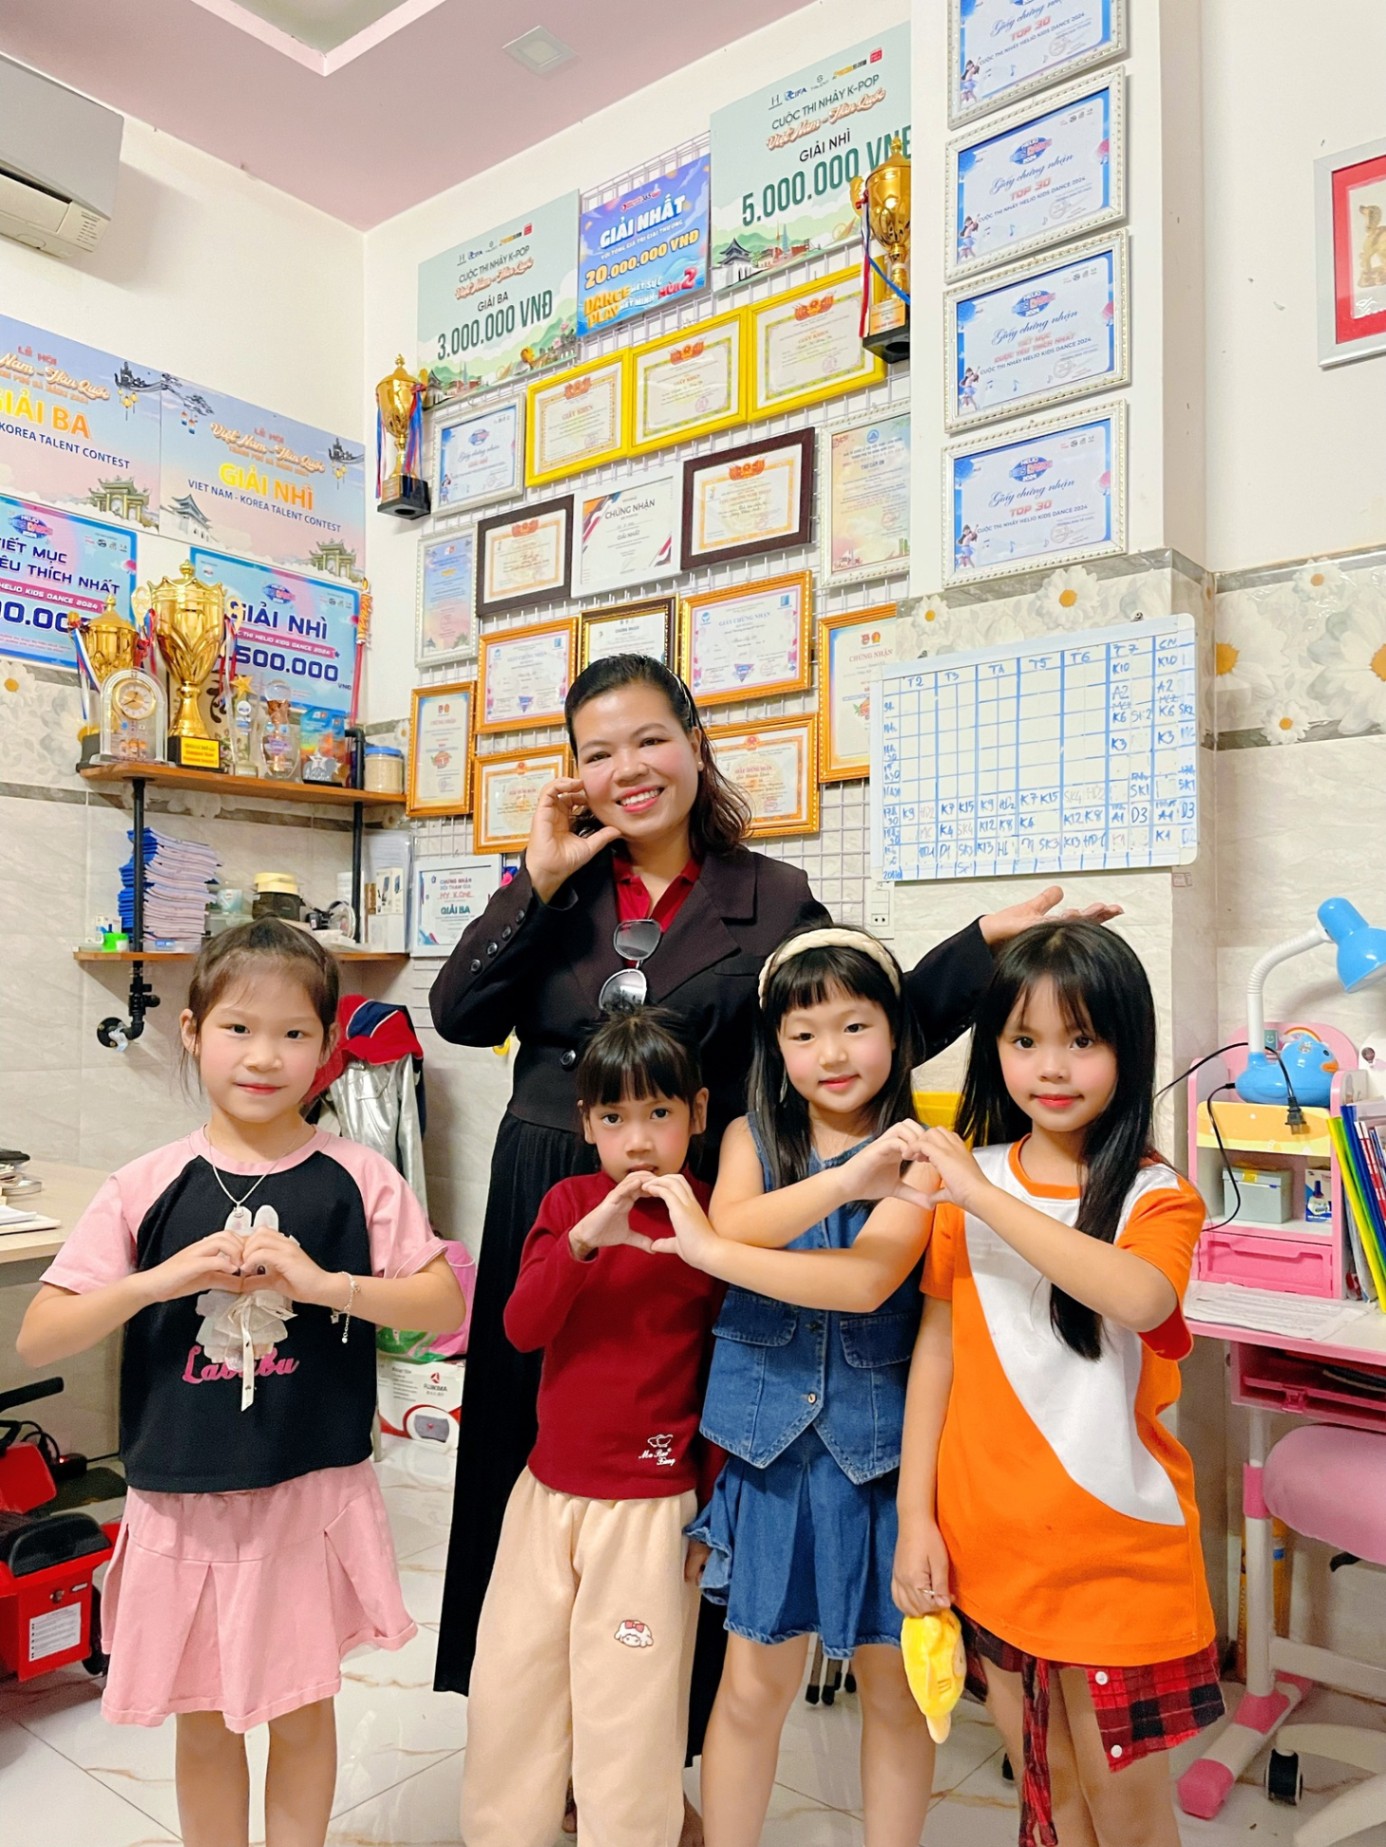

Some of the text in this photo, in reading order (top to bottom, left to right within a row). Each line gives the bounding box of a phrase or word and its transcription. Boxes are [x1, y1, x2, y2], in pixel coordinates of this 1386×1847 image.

[1011, 16, 1051, 41] TOP 30
[771, 74, 879, 130] CUỘC THI NHẢY K-POP
[800, 140, 825, 162] GIẢI
[742, 148, 859, 226] 5.000.000
[1011, 177, 1051, 201] TOP 30
[600, 216, 634, 249] GIẢI
[637, 194, 686, 233] NHẤT
[509, 245, 530, 262] K-POP
[585, 242, 668, 290] 20.000.000
[682, 266, 698, 289] 2
[477, 291, 509, 312] GIẢI BA
[437, 289, 553, 361] 3.000.000 VNĐ
[587, 303, 621, 328] PLAY
[1056, 342, 1076, 352] DANCE
[52, 405, 92, 440] BA
[39, 433, 80, 453] TALENT
[82, 448, 130, 469] CONTEST
[219, 462, 268, 496] GIẢI
[274, 479, 314, 511] NHÌ
[187, 478, 341, 532] VIET NAM KOREA TALENT CONTEST
[1009, 500, 1052, 517] TOP 30
[1052, 507, 1072, 516] DANCE
[33, 546, 67, 564] MỤC
[0, 555, 120, 594] ÊU THÍCH NHẤT
[0, 582, 98, 610] HELIO KIDS DANCE 2024
[288, 616, 327, 640] NHÌ
[908, 677, 924, 687] T2
[1070, 651, 1091, 664] T6
[1112, 655, 1178, 675] K10 K10
[1112, 679, 1173, 700] A2 A2
[1113, 712, 1127, 723] K6
[1159, 704, 1175, 717] K6
[1111, 737, 1127, 752] K3
[1158, 730, 1175, 744] K3
[1021, 793, 1038, 805] K7
[1040, 791, 1060, 804] K15
[1130, 784, 1150, 798] SK1
[1131, 807, 1148, 824] D3
[459, 906, 470, 914] BA
